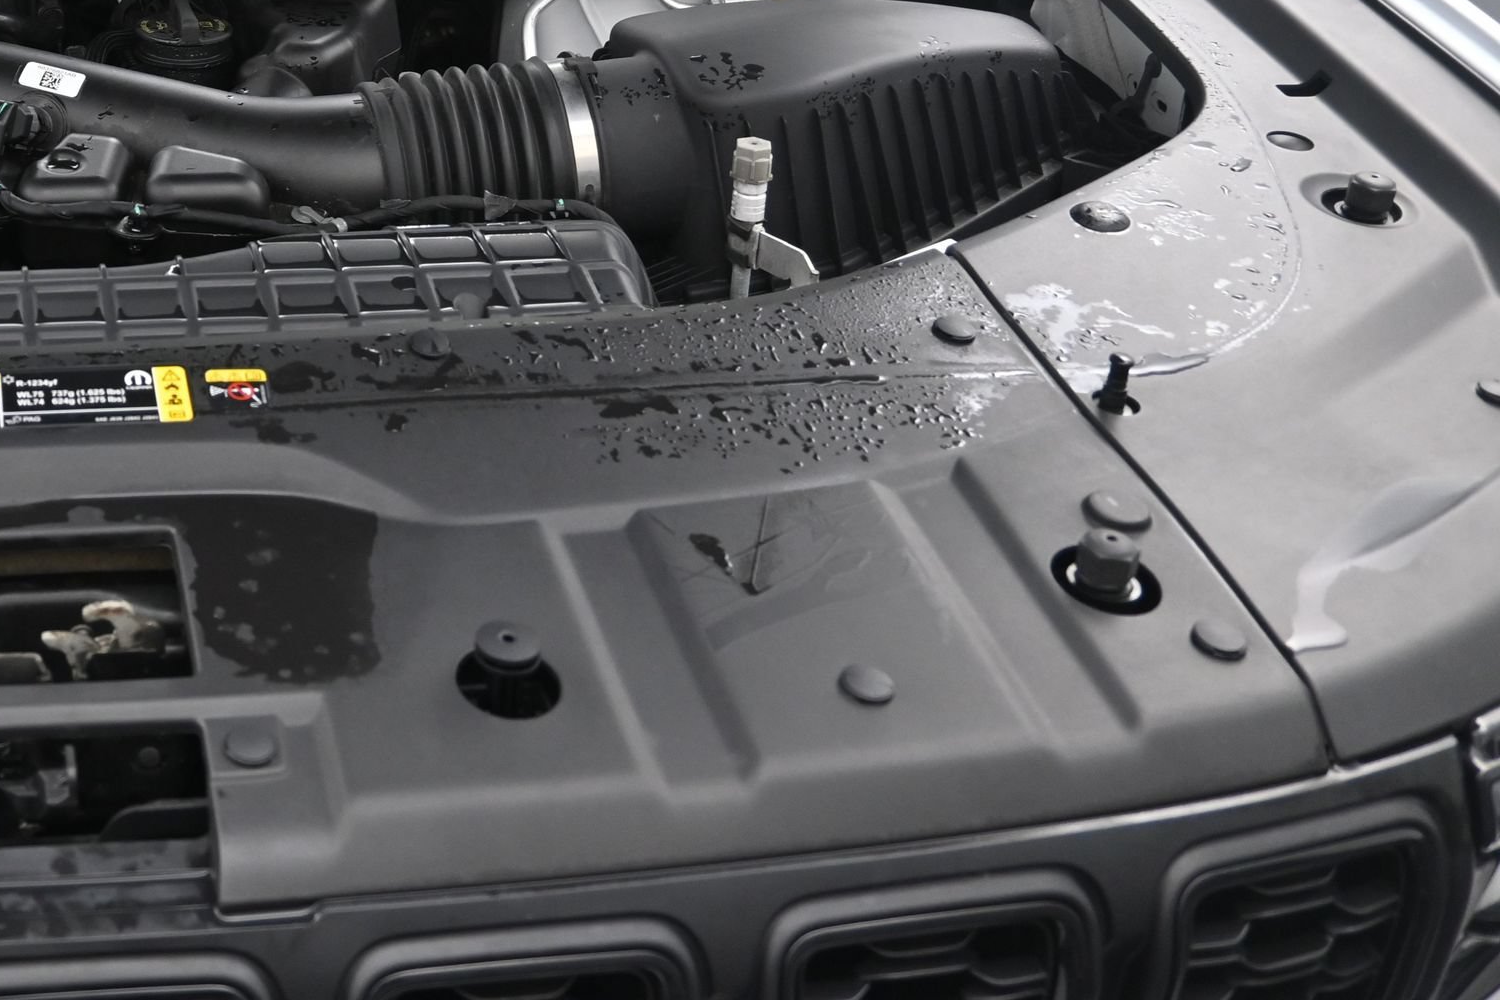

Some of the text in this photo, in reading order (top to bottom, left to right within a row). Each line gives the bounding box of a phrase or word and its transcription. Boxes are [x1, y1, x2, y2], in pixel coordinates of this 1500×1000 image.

[15, 379, 57, 387] R-1234yf
[16, 390, 45, 398] WL75
[106, 388, 125, 396] lbs)
[17, 398, 45, 406] WL74
[107, 395, 126, 403] lbs)
